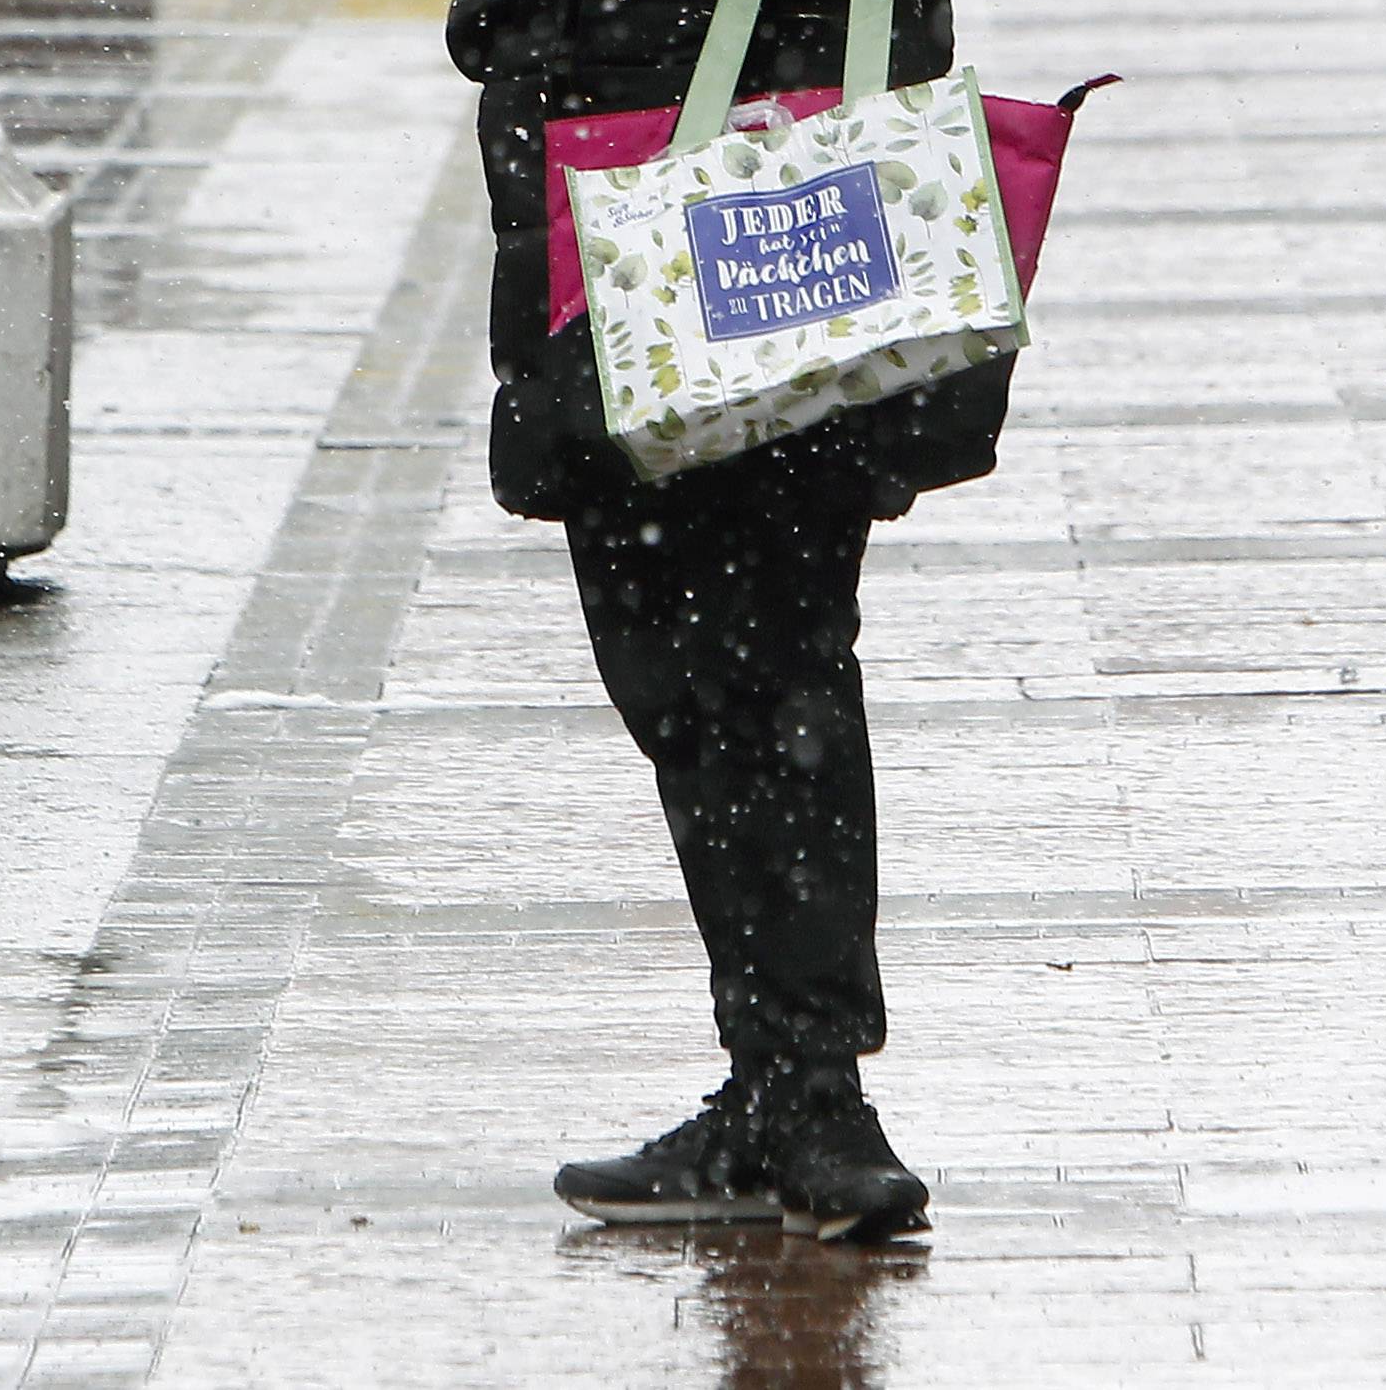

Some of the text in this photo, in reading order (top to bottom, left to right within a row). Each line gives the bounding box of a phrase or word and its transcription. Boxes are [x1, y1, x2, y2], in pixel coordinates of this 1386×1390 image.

[720, 185, 848, 246] JEDER
[716, 239, 872, 290] Päckchen
[759, 234, 795, 256] hat
[751, 271, 871, 321] TRAGEN
